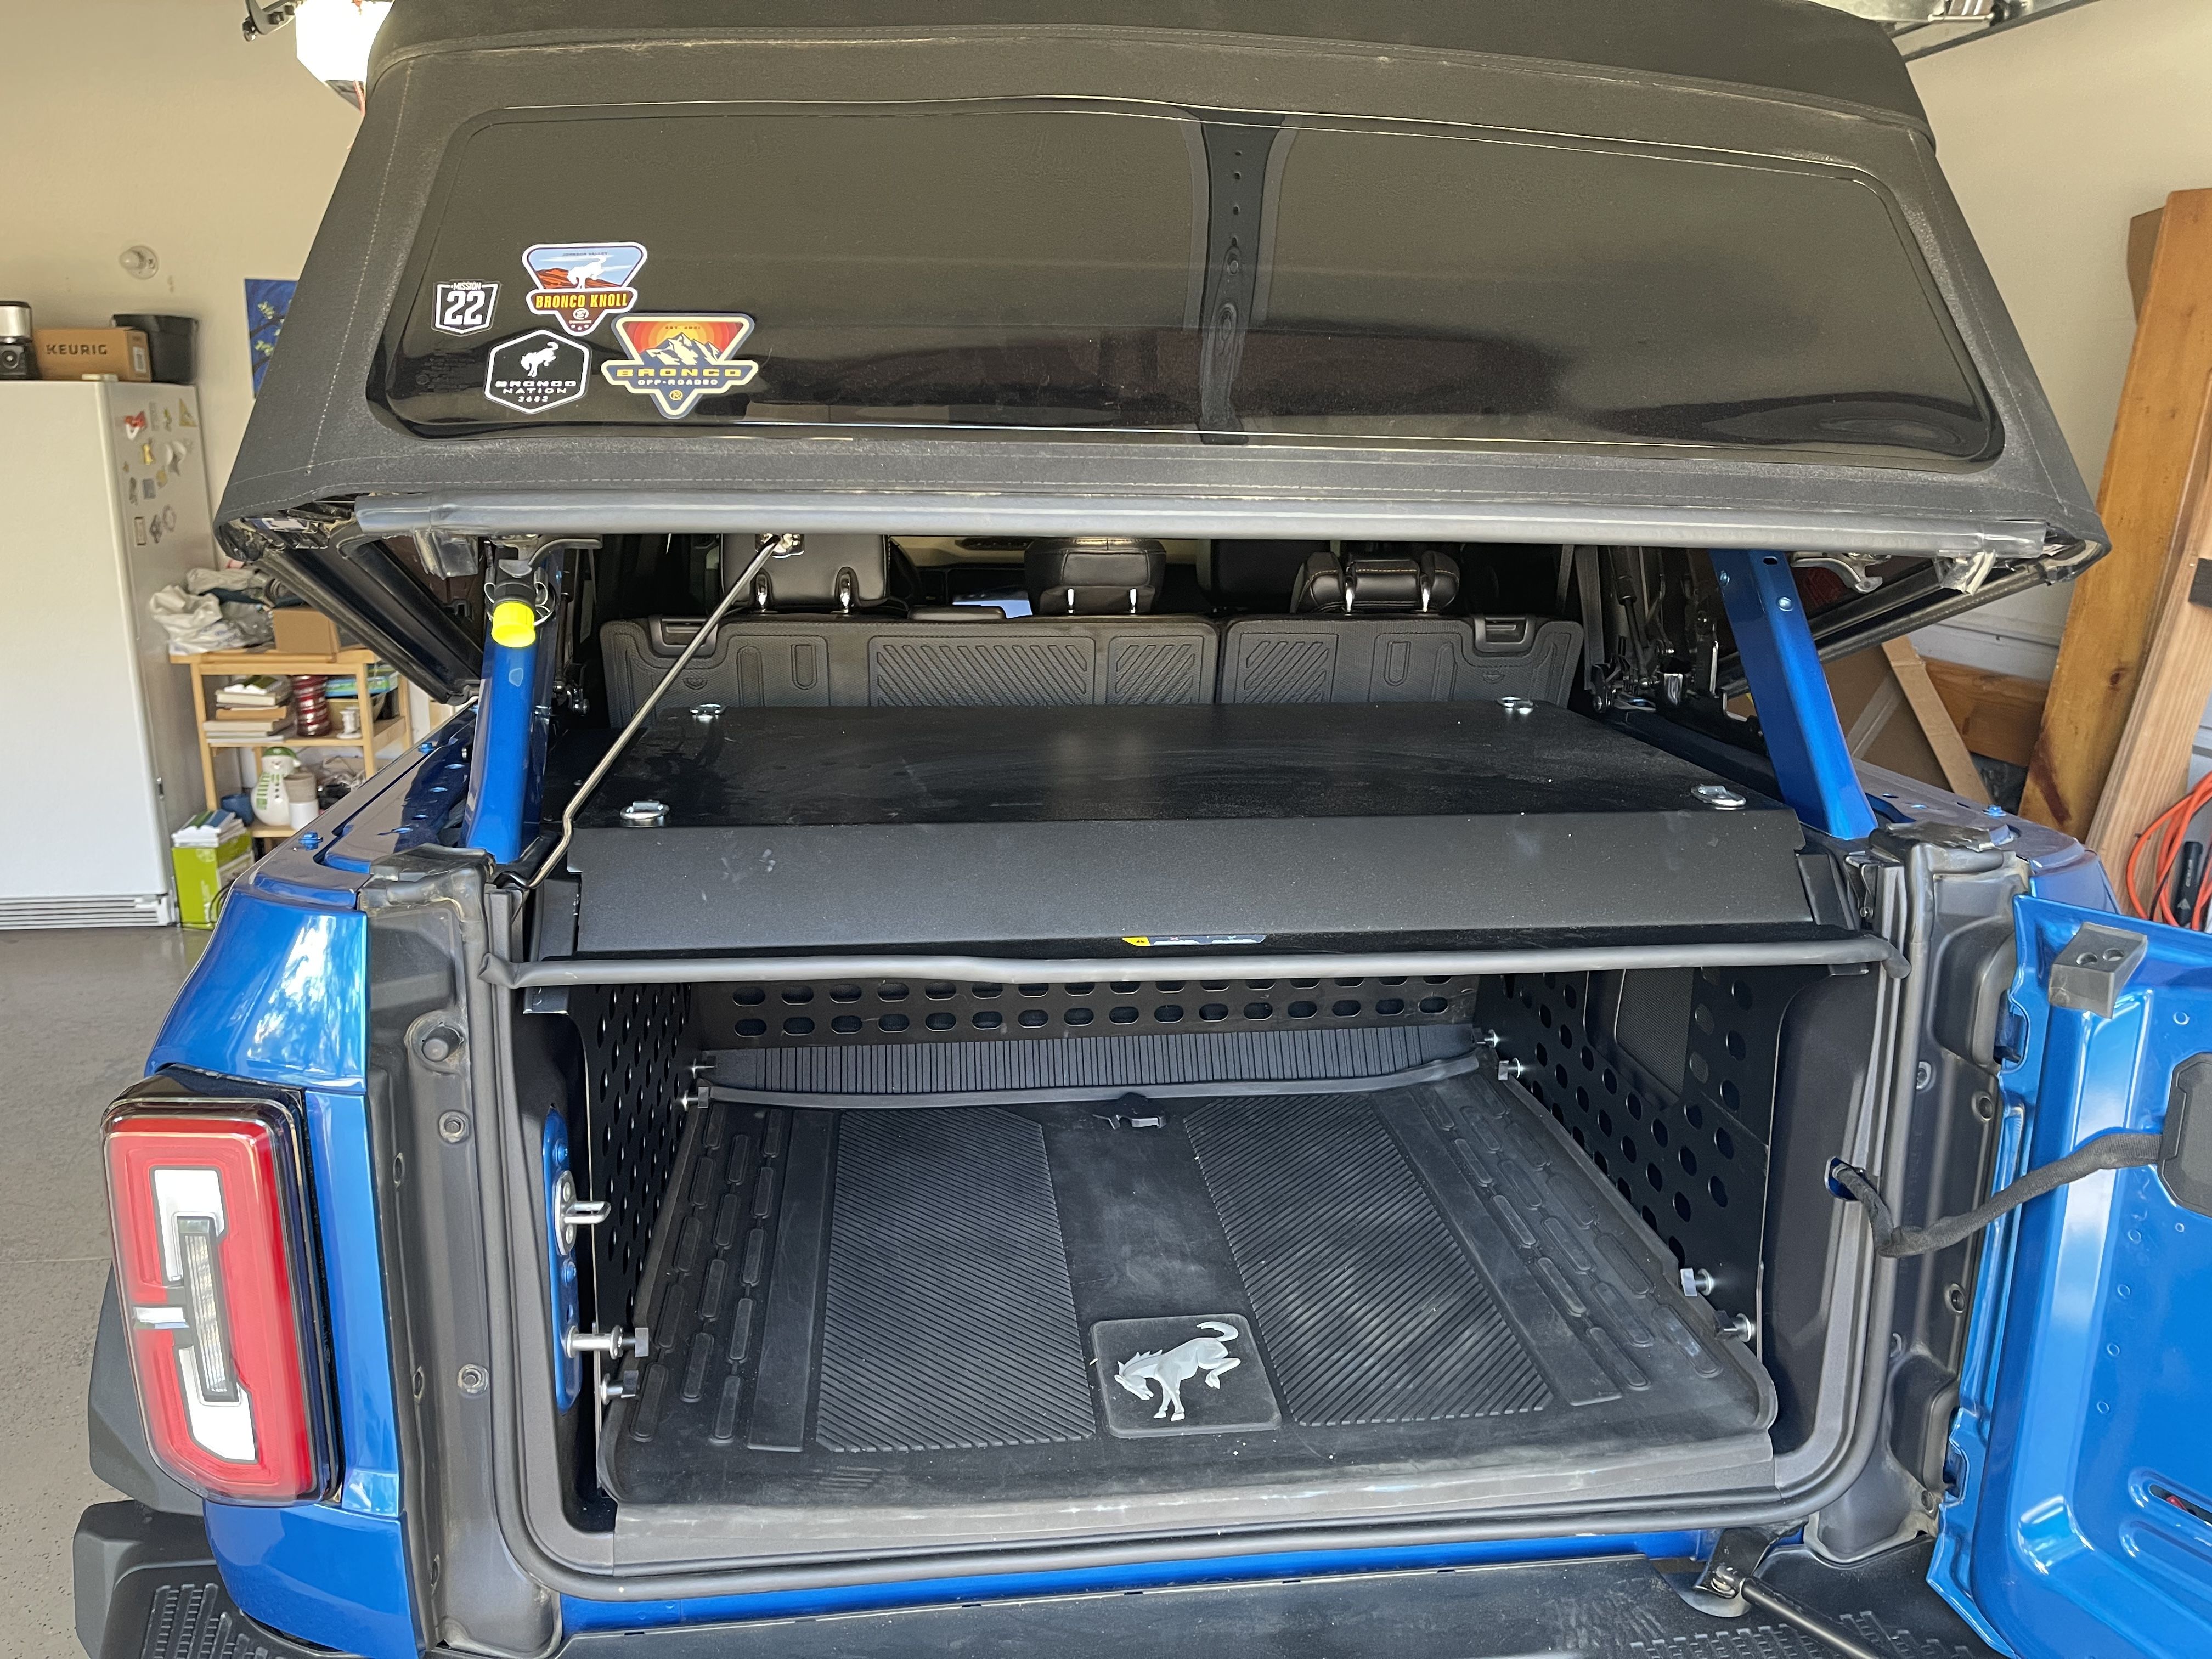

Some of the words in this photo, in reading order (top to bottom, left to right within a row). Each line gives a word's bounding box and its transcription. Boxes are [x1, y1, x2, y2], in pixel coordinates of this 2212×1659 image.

[454, 281, 482, 290] MISSION
[535, 295, 585, 308] BRONCO
[590, 293, 627, 307] KNOLL
[444, 290, 485, 325] 22
[46, 344, 108, 355] KEURIG
[616, 368, 741, 377] BRONCO
